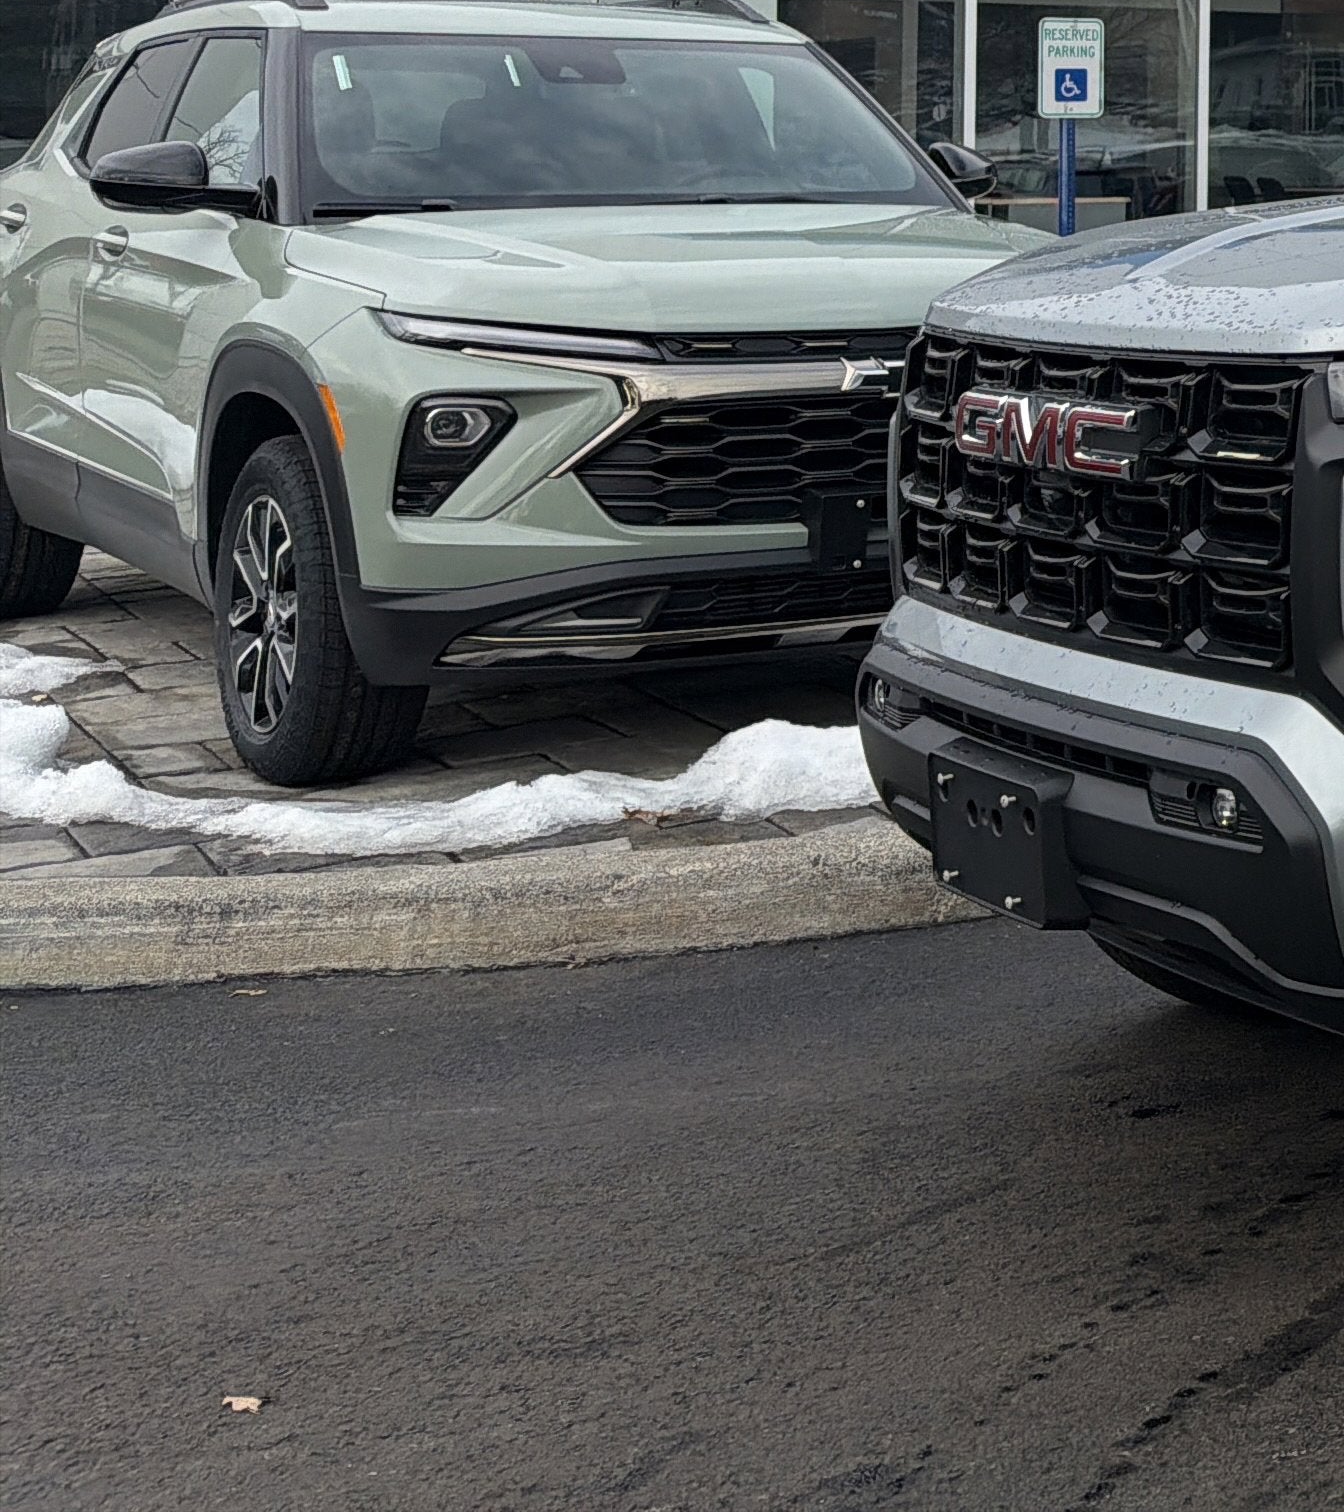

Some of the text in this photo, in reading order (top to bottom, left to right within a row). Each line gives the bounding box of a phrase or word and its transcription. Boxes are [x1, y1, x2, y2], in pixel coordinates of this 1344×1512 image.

[1044, 28, 1099, 41] RESERVED
[1047, 45, 1096, 58] PARKING
[955, 390, 1137, 480] GMC
